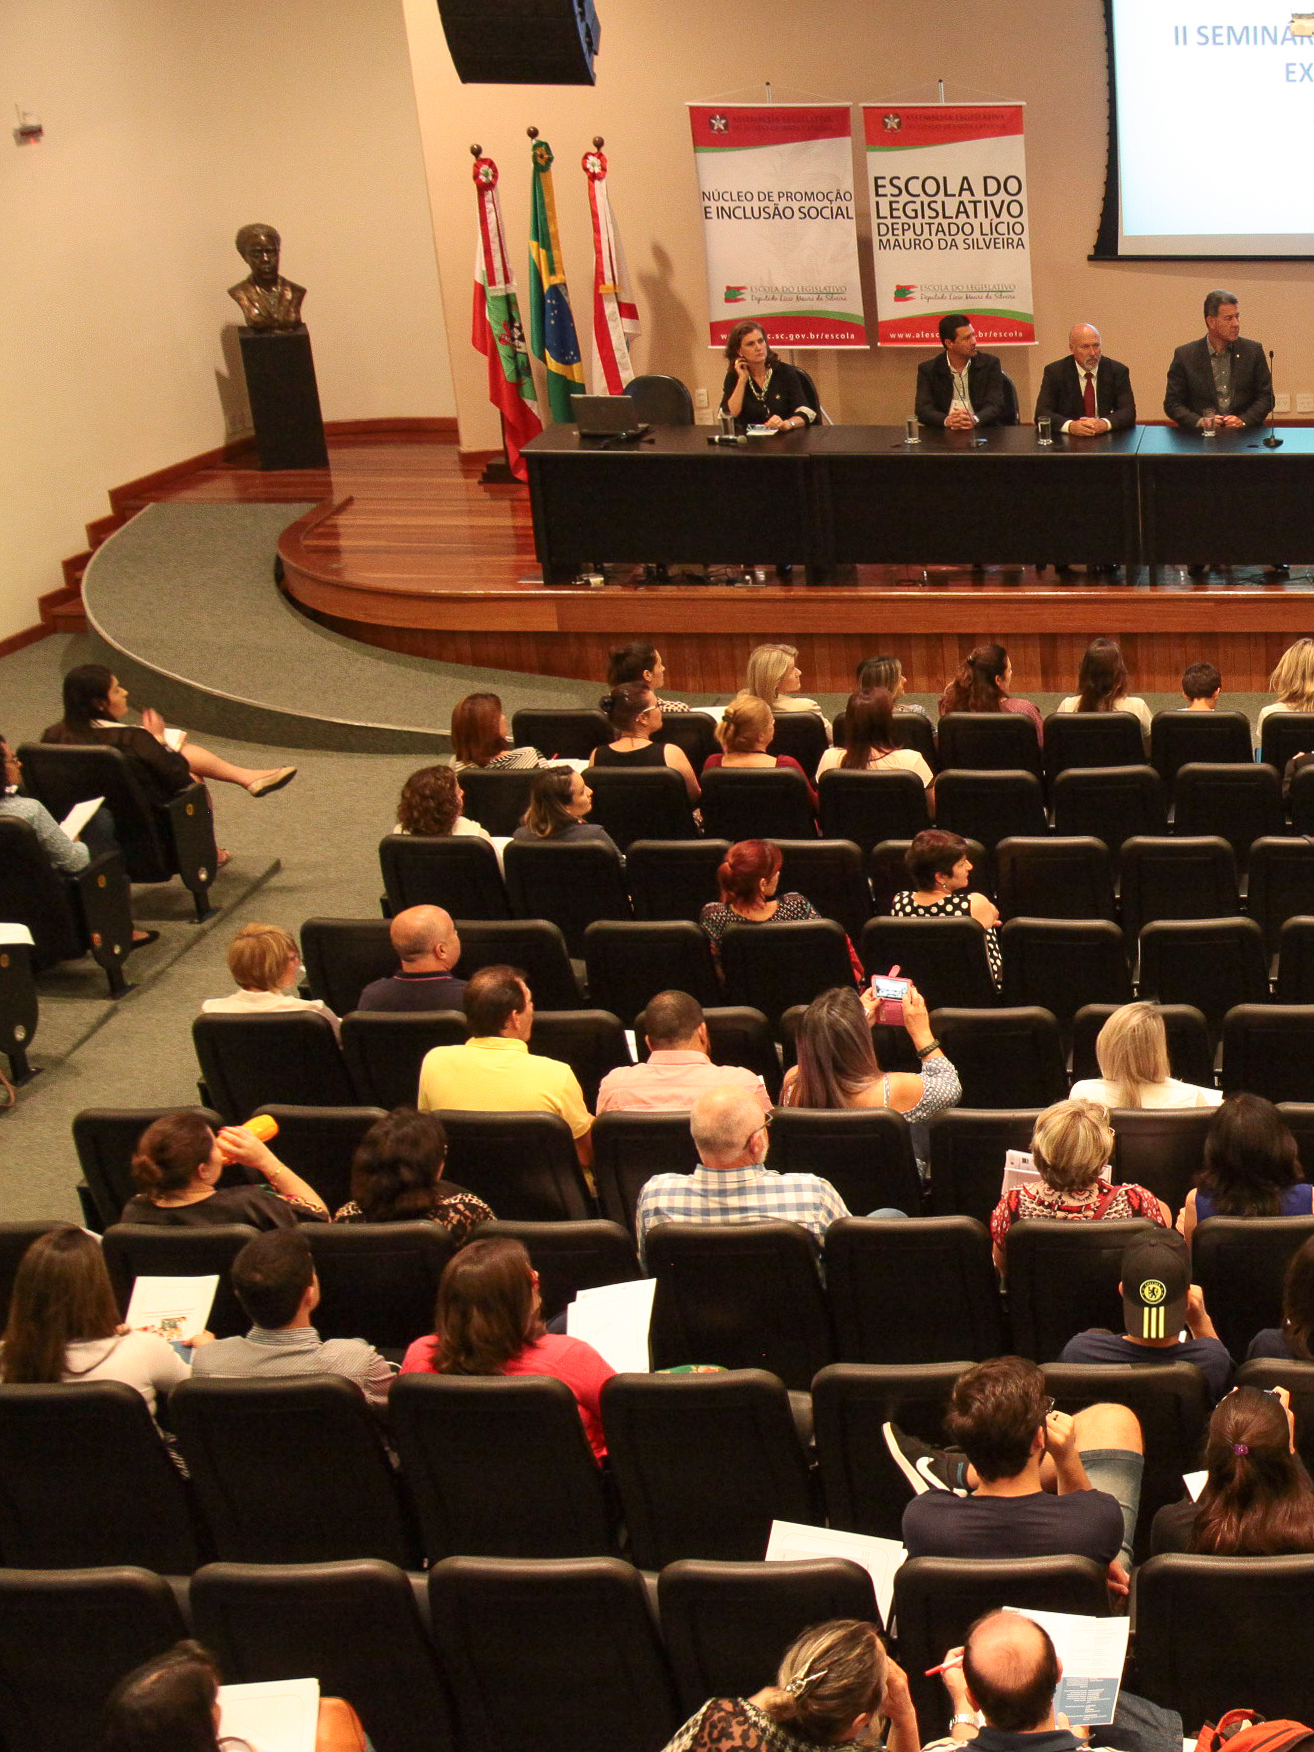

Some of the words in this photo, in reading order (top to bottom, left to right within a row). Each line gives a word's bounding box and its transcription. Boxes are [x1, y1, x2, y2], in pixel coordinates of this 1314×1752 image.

[1173, 25, 1188, 46] II
[874, 175, 975, 198] ESCOLA
[983, 175, 1023, 197] DO
[702, 189, 754, 202] NÚCLEO
[757, 191, 774, 202] DE
[777, 189, 853, 204] PROMOÇÃO
[704, 206, 713, 220] E
[716, 204, 795, 220] INCLUSÃO
[798, 206, 854, 220] SOCIAL
[875, 200, 1024, 220] LEGISLATIVO
[876, 221, 975, 237] DEPUTADO
[980, 219, 1025, 236] LÍCIO
[877, 238, 933, 251] MAURO
[937, 238, 959, 251] DA
[962, 236, 1026, 250] SILVEIRA
